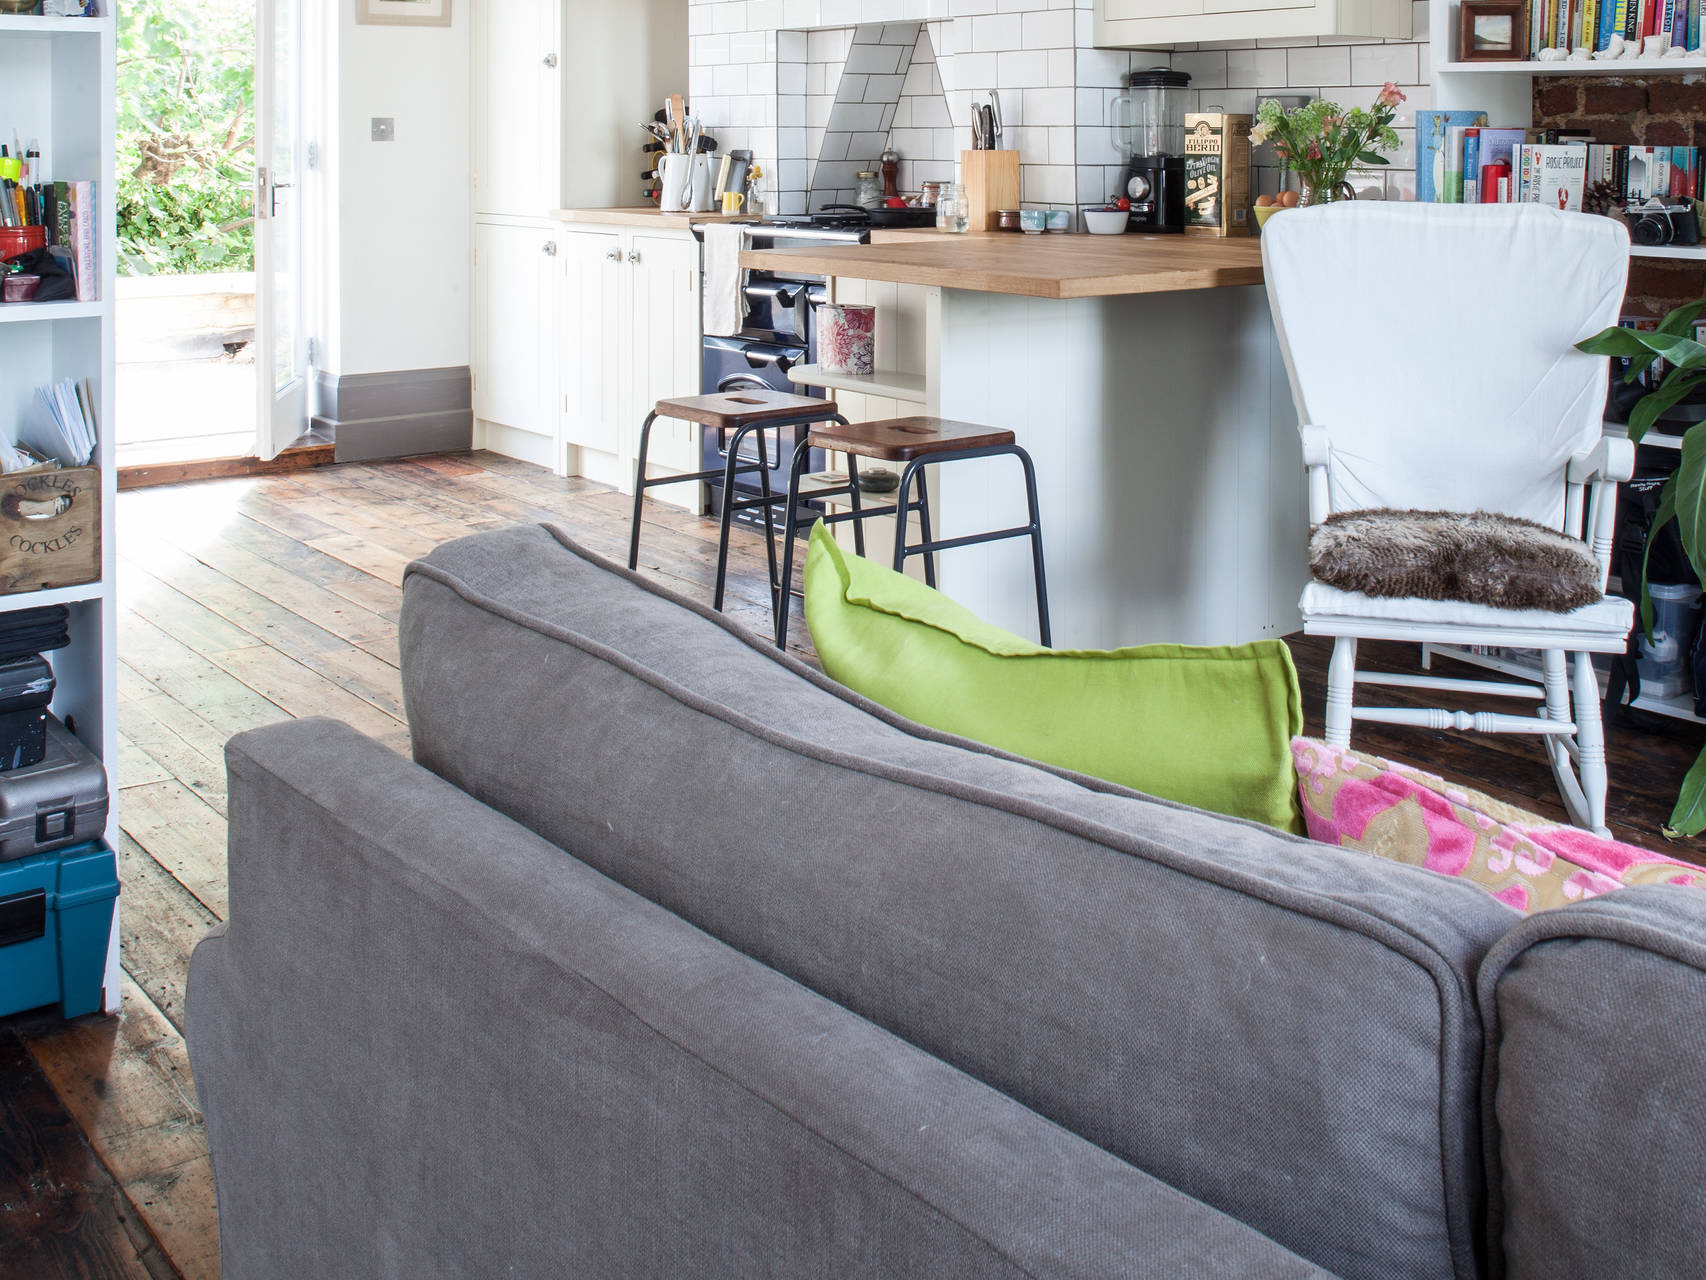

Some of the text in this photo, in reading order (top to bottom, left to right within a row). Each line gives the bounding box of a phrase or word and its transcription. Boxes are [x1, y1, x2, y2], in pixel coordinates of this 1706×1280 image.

[1627, 13, 1637, 33] KING
[1186, 144, 1219, 152] BERIO
[1186, 155, 1219, 171] EXTRA VIRGIN
[1522, 148, 1530, 190] GOOD IDEAS
[1545, 156, 1584, 169] ROSIE PROJECT
[1657, 163, 1665, 177] dice
[1189, 163, 1216, 179] OLIVE OIL
[1532, 174, 1542, 192] ROSIE
[1532, 193, 1541, 203] PR
[14, 475, 82, 498] OCKLES
[9, 525, 83, 555] COCKLES
